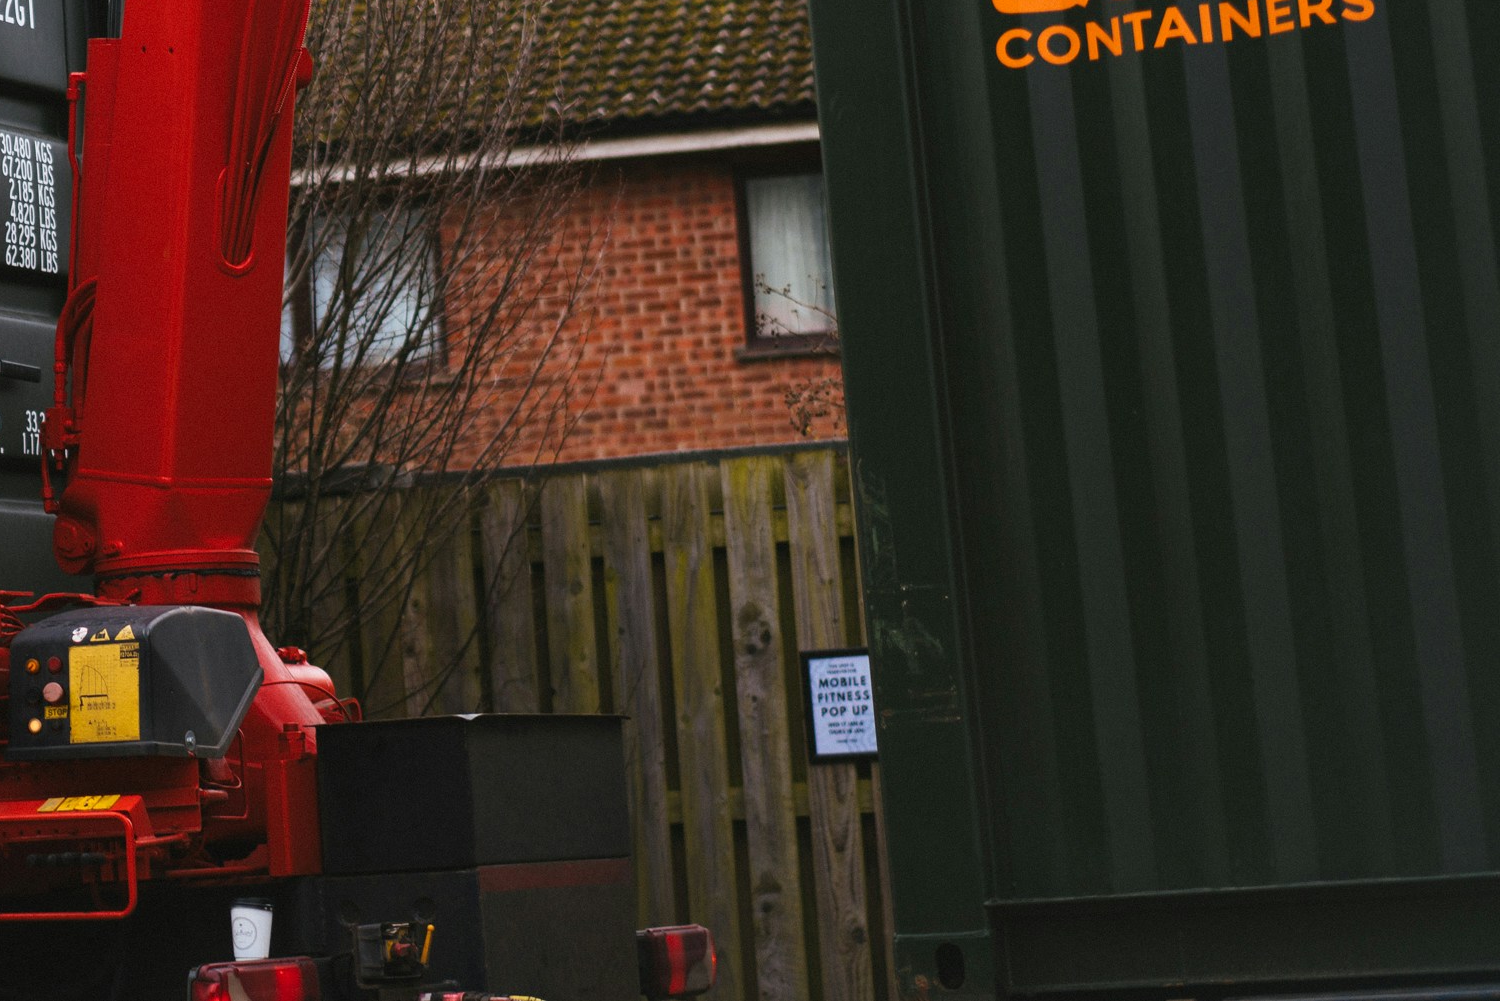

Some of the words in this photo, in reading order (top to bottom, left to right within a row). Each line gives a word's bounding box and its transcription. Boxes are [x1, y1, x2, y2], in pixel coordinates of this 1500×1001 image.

[0, 133, 31, 160] 30.480
[34, 141, 52, 164] KGS
[2, 156, 33, 181] 67.200
[36, 162, 54, 186] LBS
[9, 179, 34, 203] 2.185
[38, 185, 55, 208] KGS
[10, 200, 35, 226] 4.820
[39, 206, 57, 230] LBS
[40, 228, 58, 252] KGS
[6, 246, 36, 270] 62.380
[41, 251, 58, 274] LBS
[819, 676, 866, 688] MOBILE
[818, 690, 870, 703] FITNESS
[48, 708, 68, 717] STOP
[821, 706, 846, 717] POP
[852, 705, 868, 716] UP
